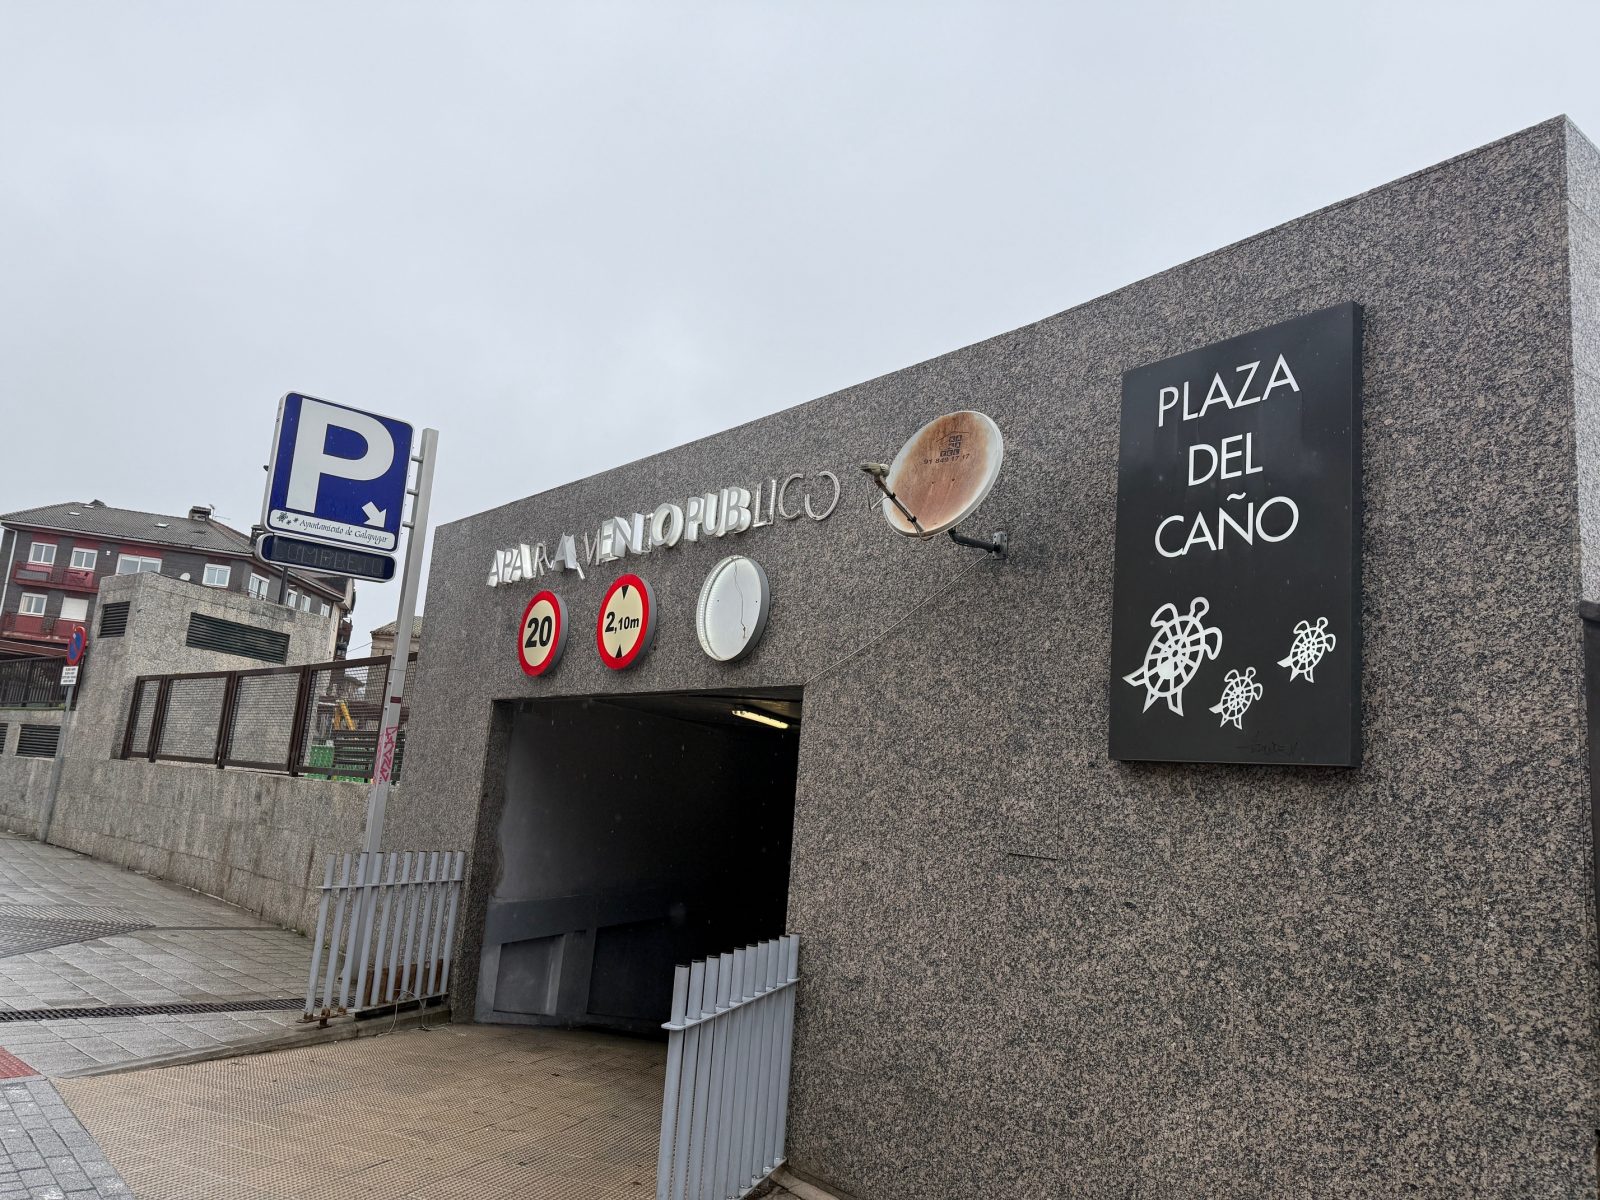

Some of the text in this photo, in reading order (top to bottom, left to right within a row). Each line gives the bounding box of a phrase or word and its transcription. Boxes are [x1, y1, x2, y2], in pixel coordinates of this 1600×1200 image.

[1157, 353, 1300, 427] PLAZA
[286, 398, 395, 514] P
[1188, 432, 1263, 487] DEL
[300, 519, 388, 545] Ayuntamiento de Galapagar
[1154, 492, 1300, 559] CAÑO
[525, 615, 553, 649] 20
[604, 611, 640, 634] 2,10m
